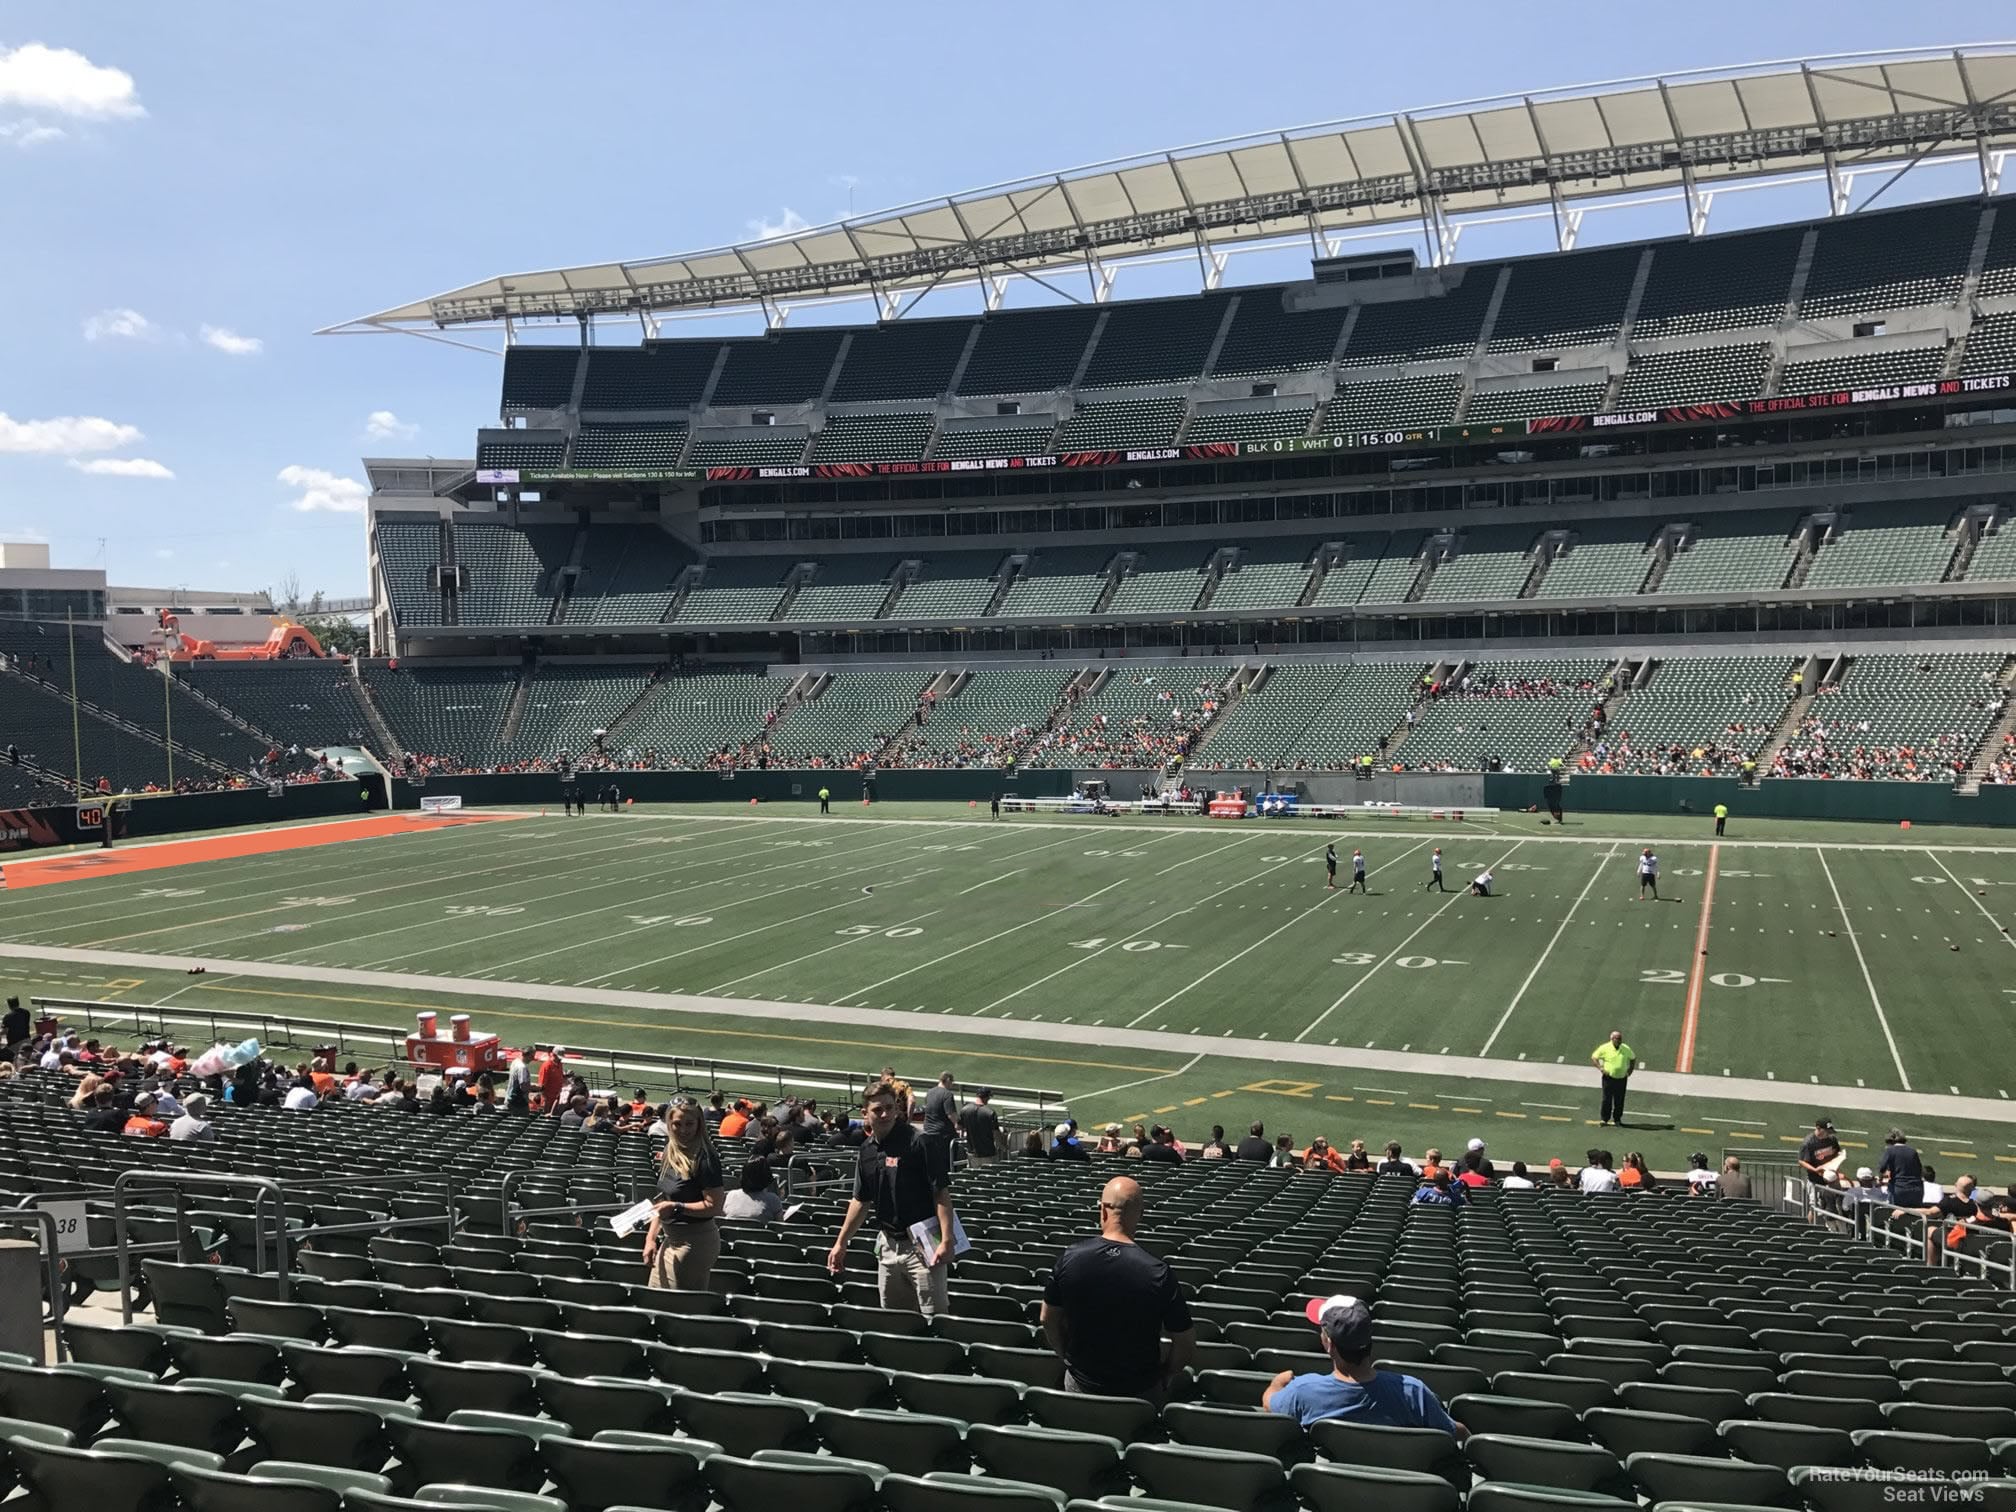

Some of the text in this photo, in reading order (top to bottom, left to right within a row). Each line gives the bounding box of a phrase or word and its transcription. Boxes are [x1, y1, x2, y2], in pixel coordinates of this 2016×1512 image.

[1748, 375, 2010, 413] THE OFFICIAL SITE FOR BENGALS NEWS AND TICKETS
[1592, 411, 1657, 426] BENGALS.COM
[1247, 443, 1268, 453] BLK
[1273, 441, 1283, 452] 0
[1302, 438, 1329, 449] WHT
[1333, 436, 1343, 448] 0
[1361, 432, 1404, 445] 15:00
[1406, 433, 1423, 441] QTR
[1428, 431, 1434, 439] 1
[1127, 449, 1180, 461] BENGALS.COM
[759, 467, 810, 478] BENGALS.COM
[878, 456, 1057, 474] THE OFFICIAL SITE FOR BENGALS NEWS AND TICKETS
[81, 809, 101, 825] 40
[834, 924, 925, 938] 50
[1066, 937, 1162, 952] 40
[1331, 952, 1438, 969] 30
[1638, 969, 1757, 988] 20
[484, 1048, 493, 1062] G
